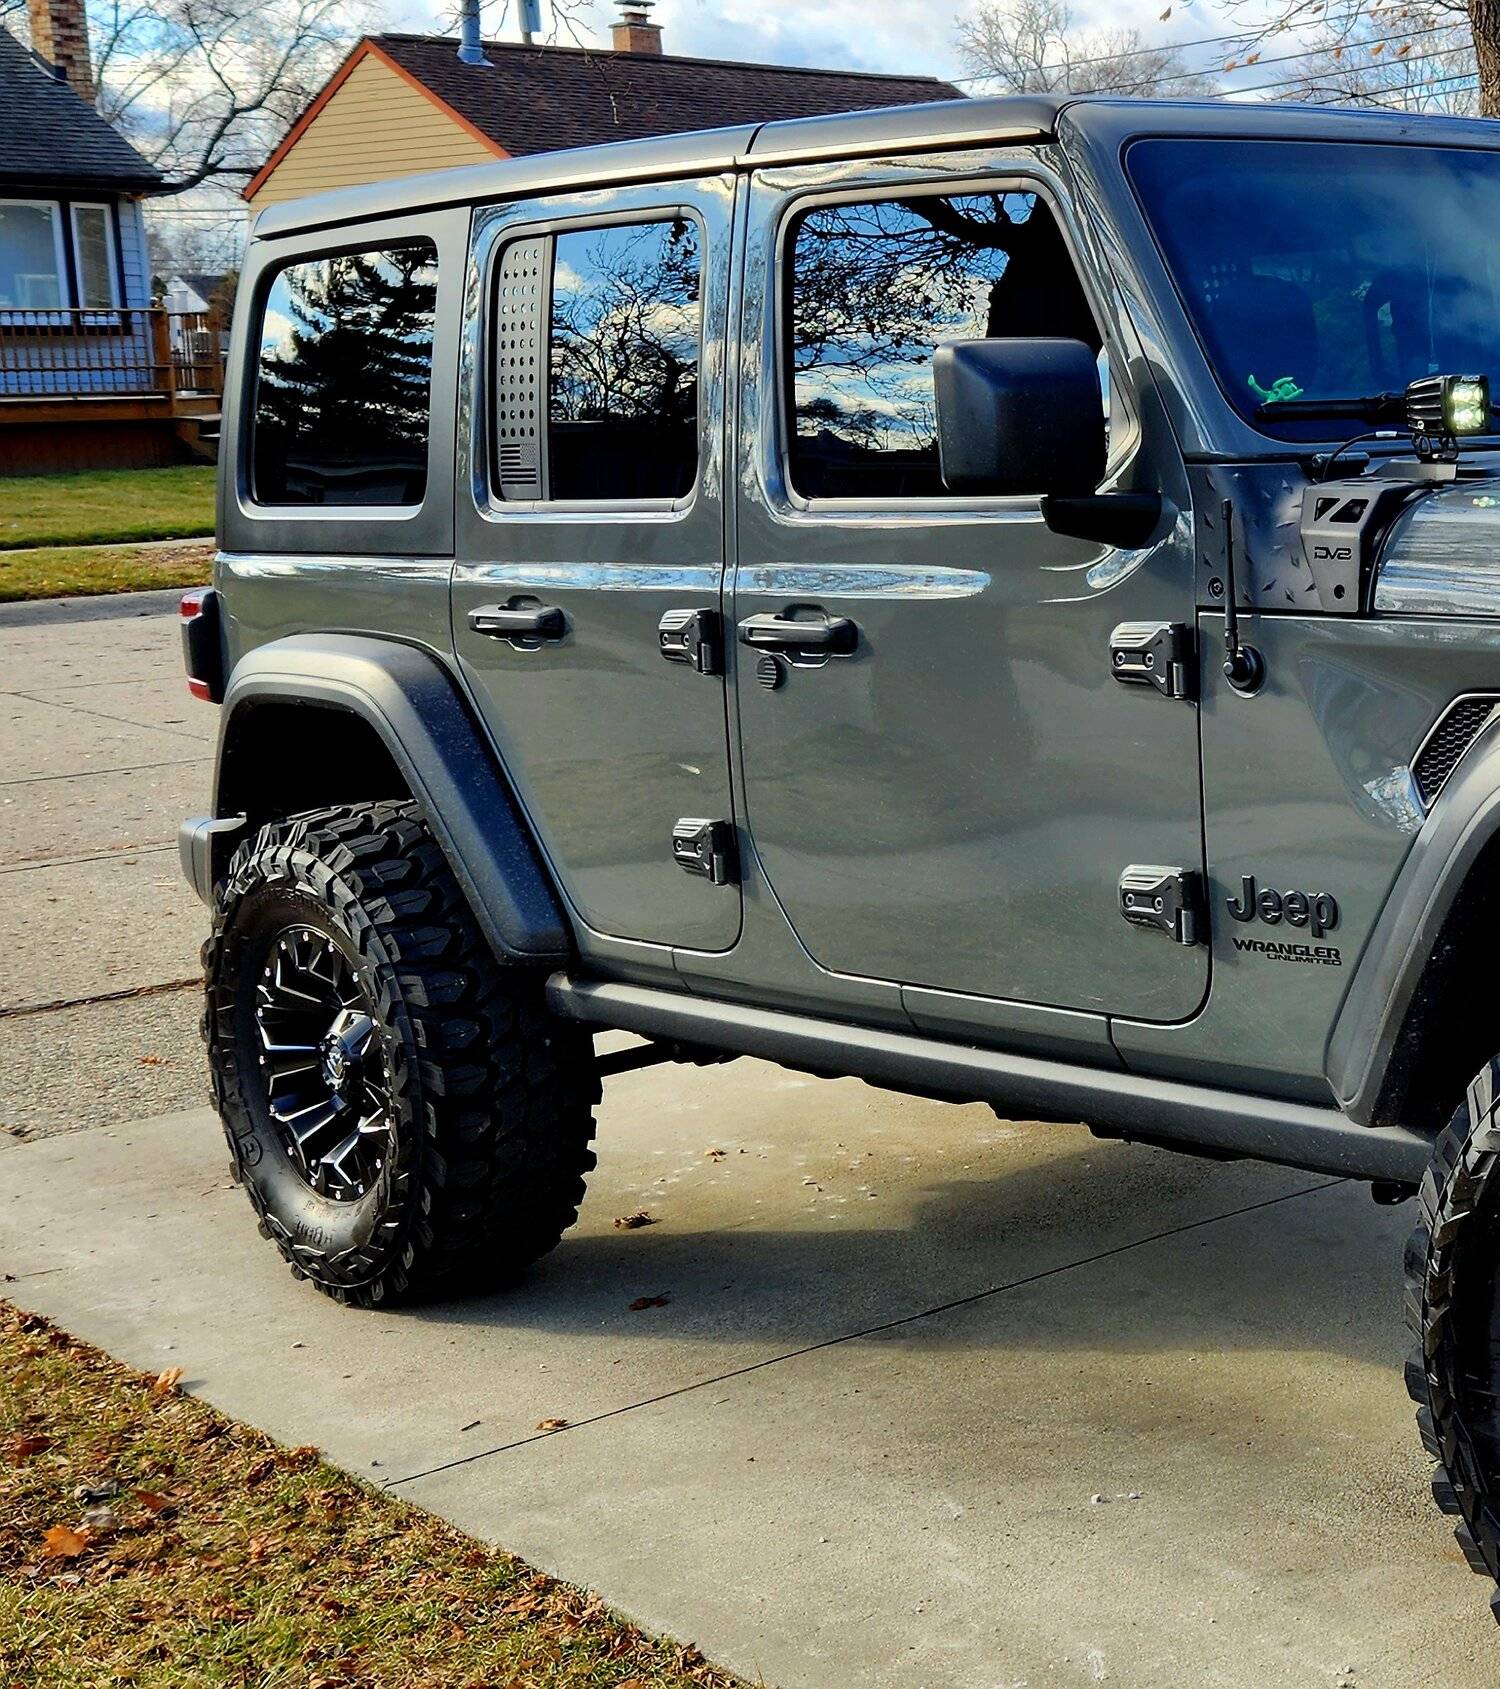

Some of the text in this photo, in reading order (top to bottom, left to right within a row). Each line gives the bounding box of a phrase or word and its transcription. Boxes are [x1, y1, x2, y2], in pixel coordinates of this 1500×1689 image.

[1226, 875, 1339, 939] Jeep
[1232, 937, 1341, 960] WRANGLER
[1266, 953, 1342, 966] UNLIMITED
